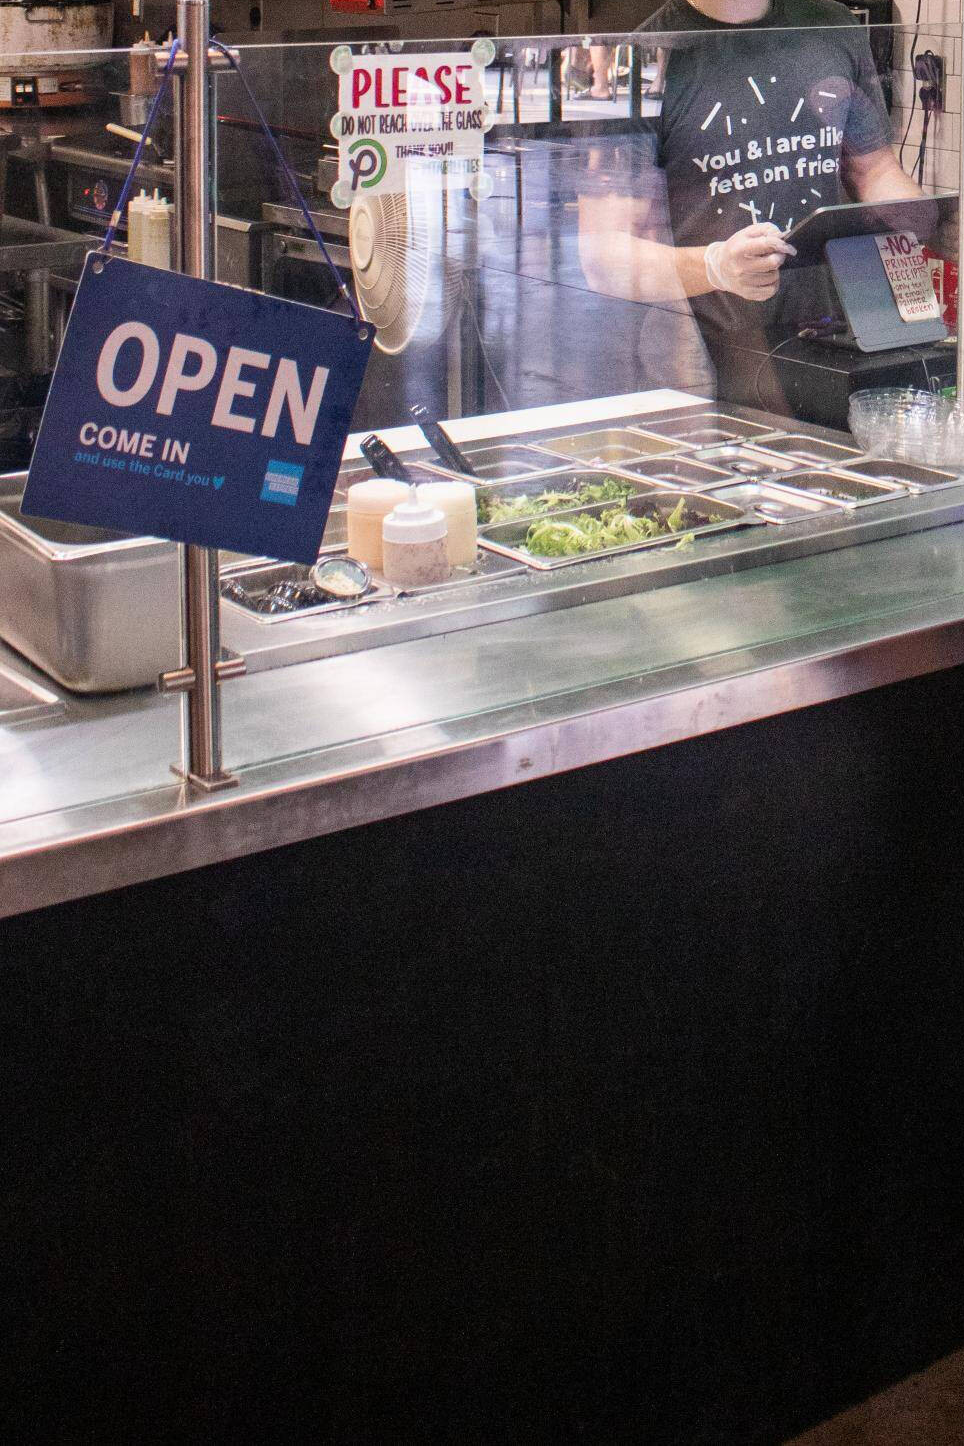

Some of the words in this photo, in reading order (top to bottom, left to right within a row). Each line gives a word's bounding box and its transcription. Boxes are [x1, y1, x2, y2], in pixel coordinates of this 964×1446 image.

[341, 115, 355, 136] DO
[358, 114, 376, 135] NOT
[379, 112, 408, 134] REACH
[456, 110, 483, 130] GLASS
[395, 145, 426, 158] THANK
[693, 149, 741, 173] You
[747, 140, 762, 160] &
[767, 137, 773, 155] I
[776, 132, 816, 154] are
[709, 172, 759, 197] feta
[763, 165, 790, 184] on
[886, 234, 912, 256] NO
[884, 255, 925, 270] PRINTED
[96, 321, 330, 446] OPEN
[79, 422, 157, 458] COME
[161, 438, 190, 465] IN
[74, 451, 100, 466] and
[102, 456, 126, 470] use
[128, 460, 151, 475] the
[153, 464, 184, 482] Card
[184, 473, 210, 487] you
